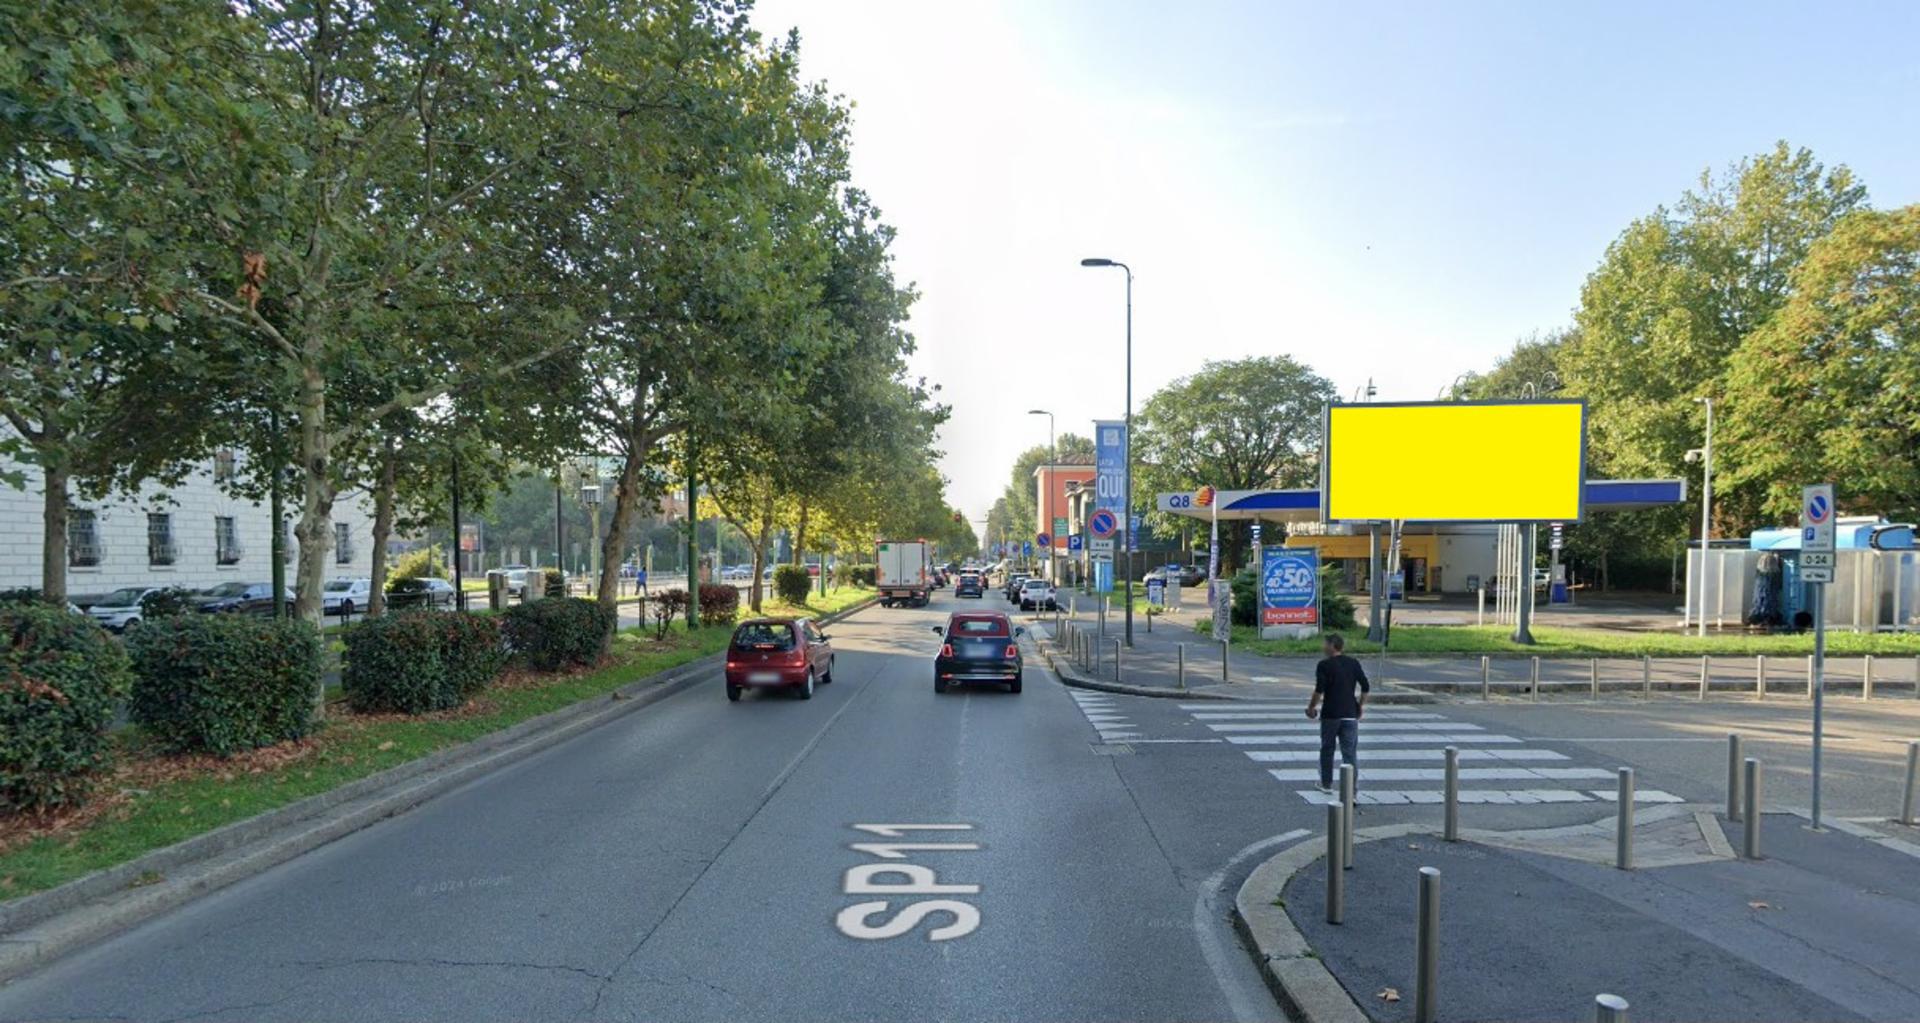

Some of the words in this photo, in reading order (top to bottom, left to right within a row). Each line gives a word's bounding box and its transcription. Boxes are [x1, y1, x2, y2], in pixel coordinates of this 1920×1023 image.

[1099, 474, 1123, 498] QUI
[1169, 495, 1190, 508] Q8
[1070, 536, 1080, 549] P
